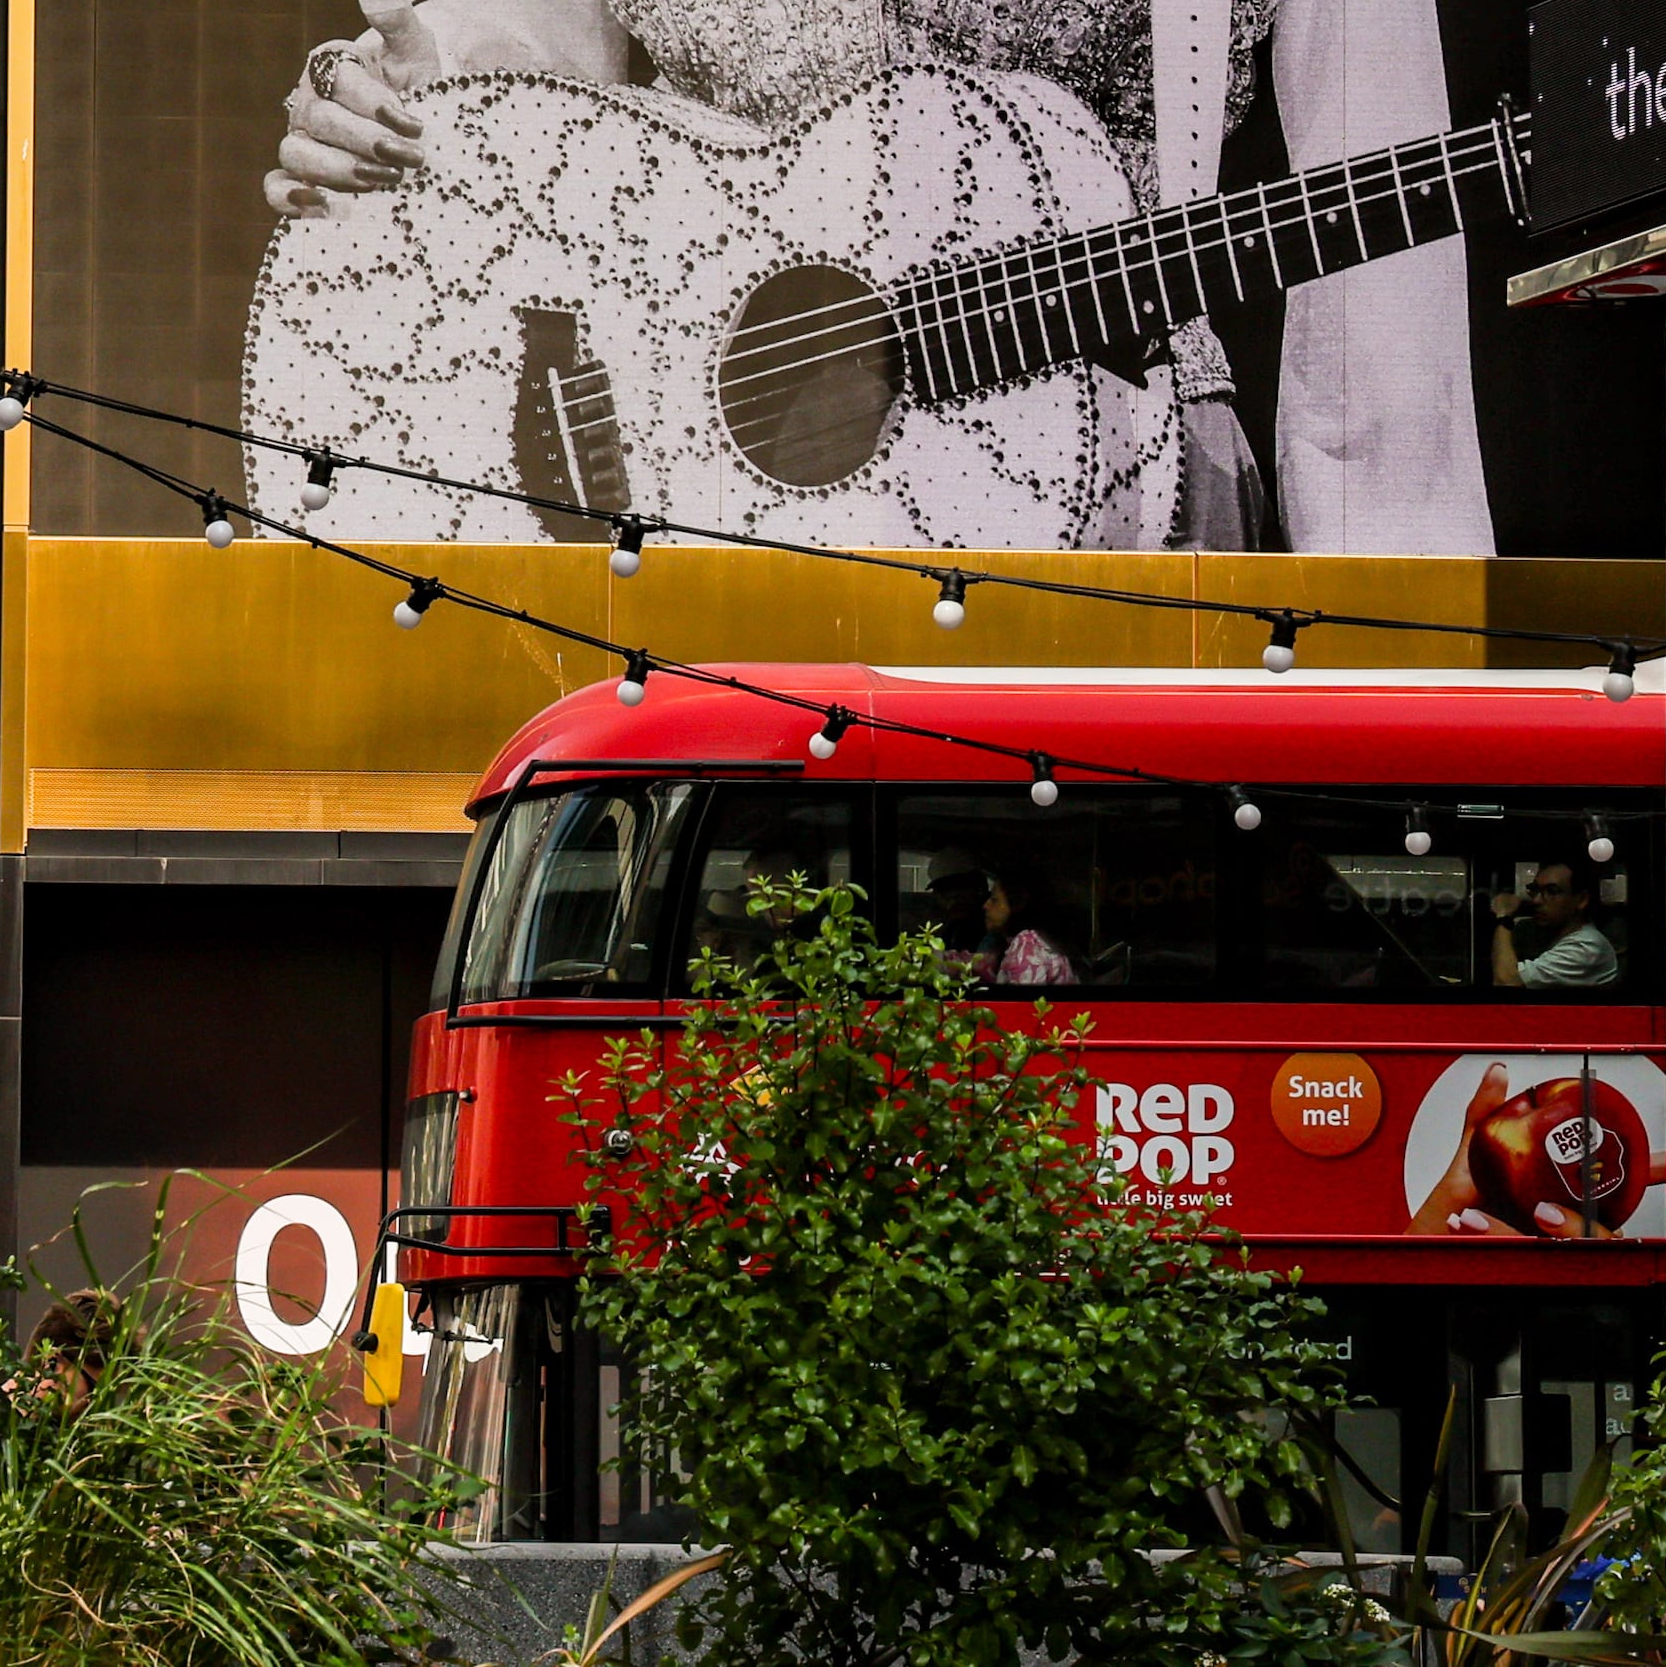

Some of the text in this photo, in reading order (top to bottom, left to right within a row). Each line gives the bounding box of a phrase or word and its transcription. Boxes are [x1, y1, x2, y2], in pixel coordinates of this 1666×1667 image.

[1289, 1075, 1364, 1098] Snack
[1302, 1104, 1350, 1126] me!
[1146, 1190, 1175, 1209] big
